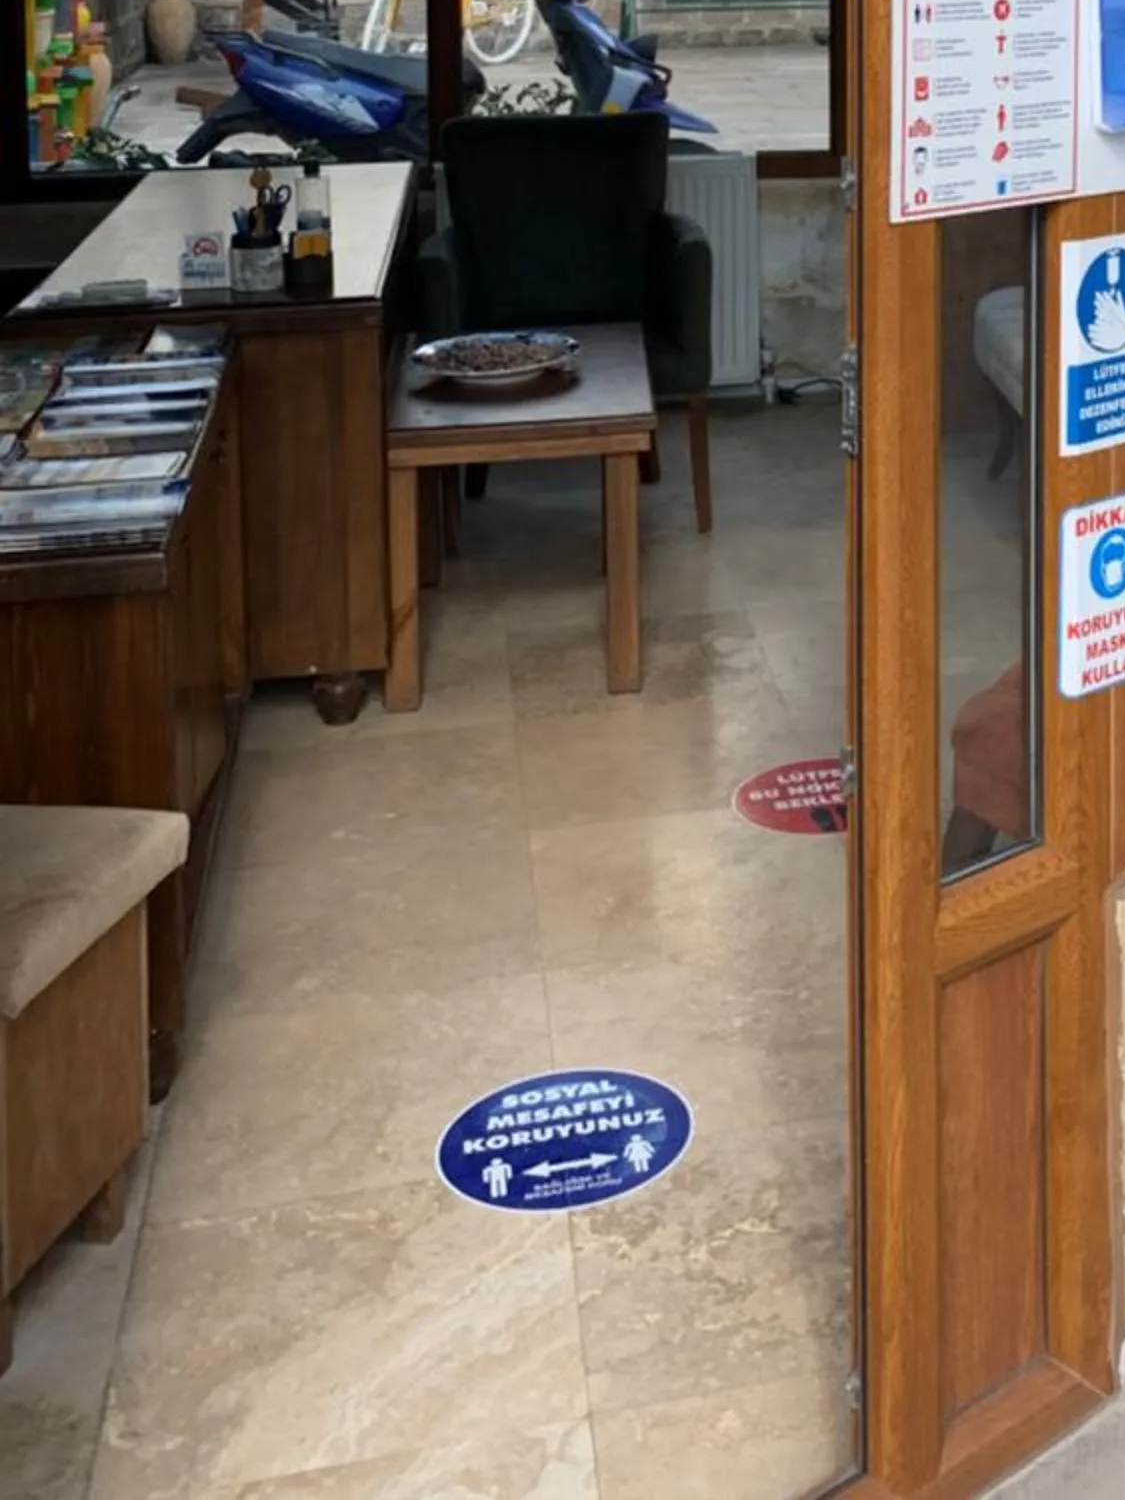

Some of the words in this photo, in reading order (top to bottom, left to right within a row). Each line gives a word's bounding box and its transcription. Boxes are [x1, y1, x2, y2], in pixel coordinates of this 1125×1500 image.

[486, 1089, 635, 1131] MESAFEYİ
[501, 1078, 619, 1109] SOSYAL
[462, 1107, 666, 1155] KORUYUNUZ
